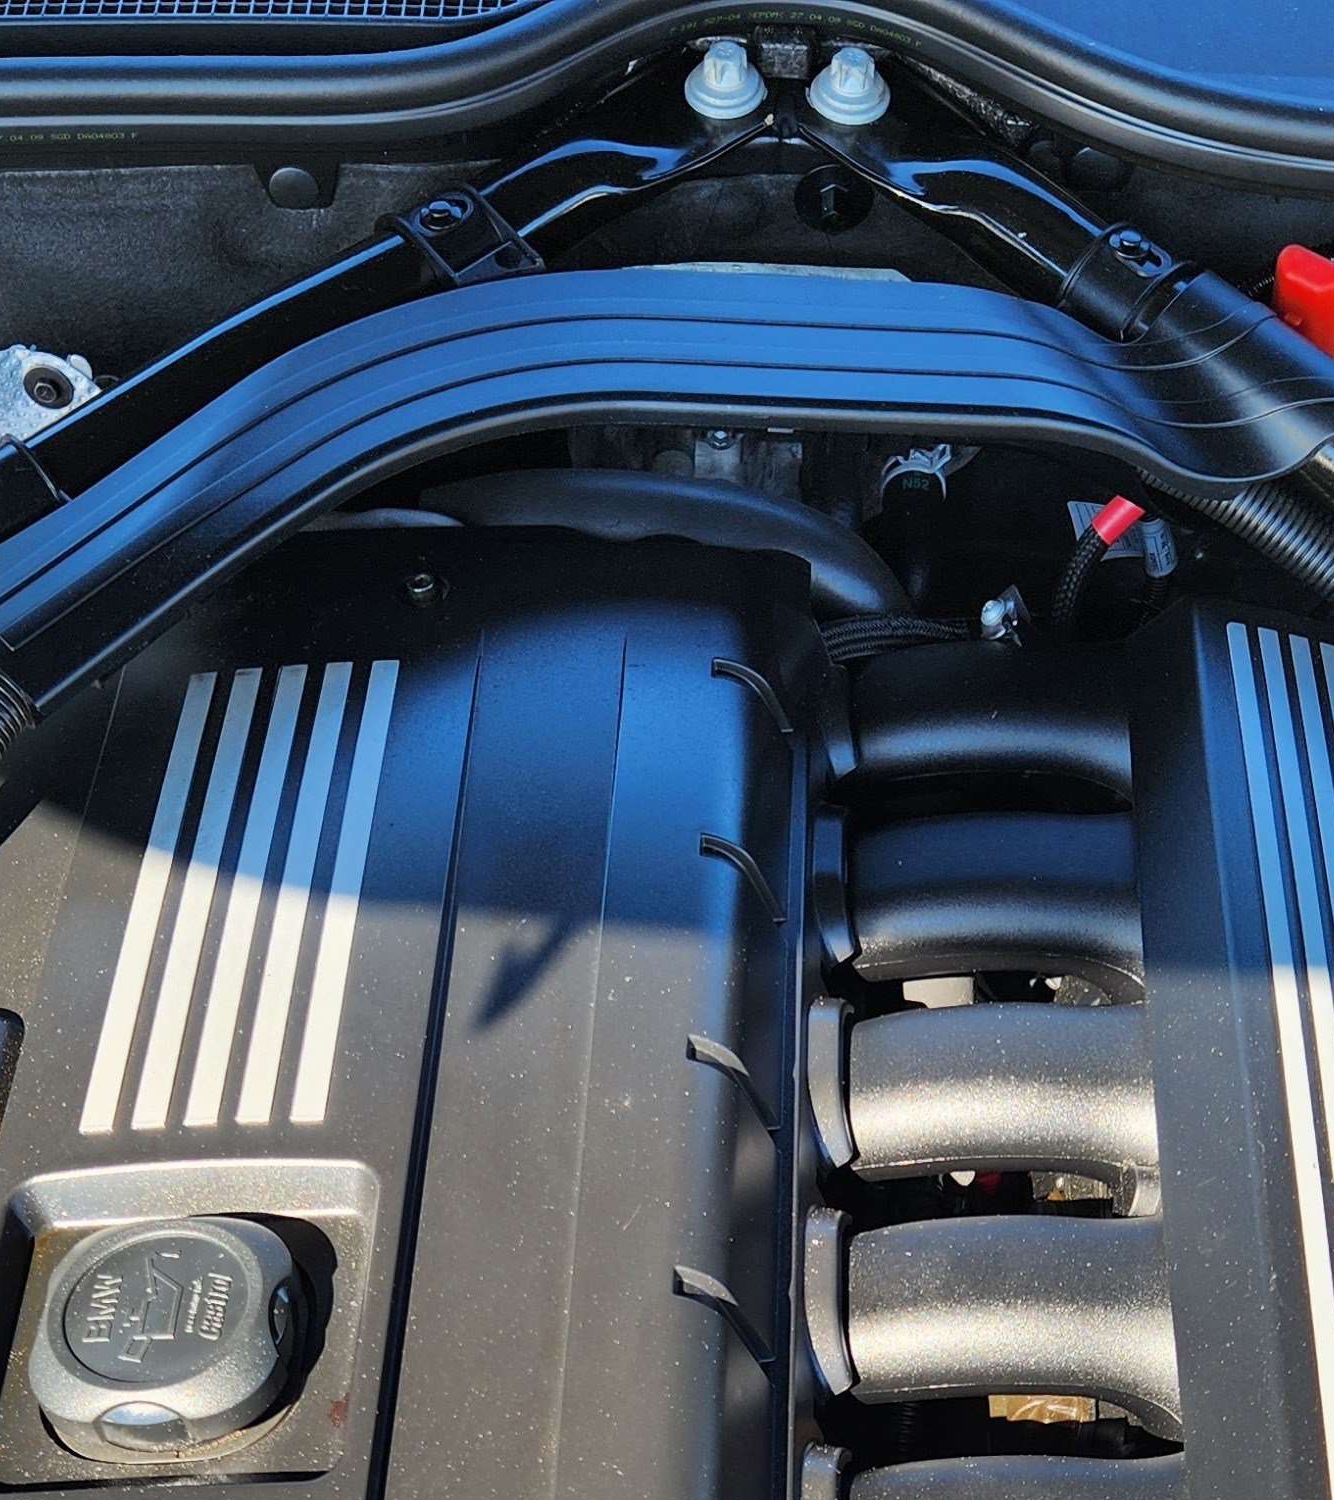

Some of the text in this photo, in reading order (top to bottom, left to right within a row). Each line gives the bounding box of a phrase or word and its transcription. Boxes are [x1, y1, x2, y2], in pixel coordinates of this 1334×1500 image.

[9, 134, 23, 142] 04
[82, 1274, 123, 1342] BMW
[198, 1272, 233, 1341] Castrol
